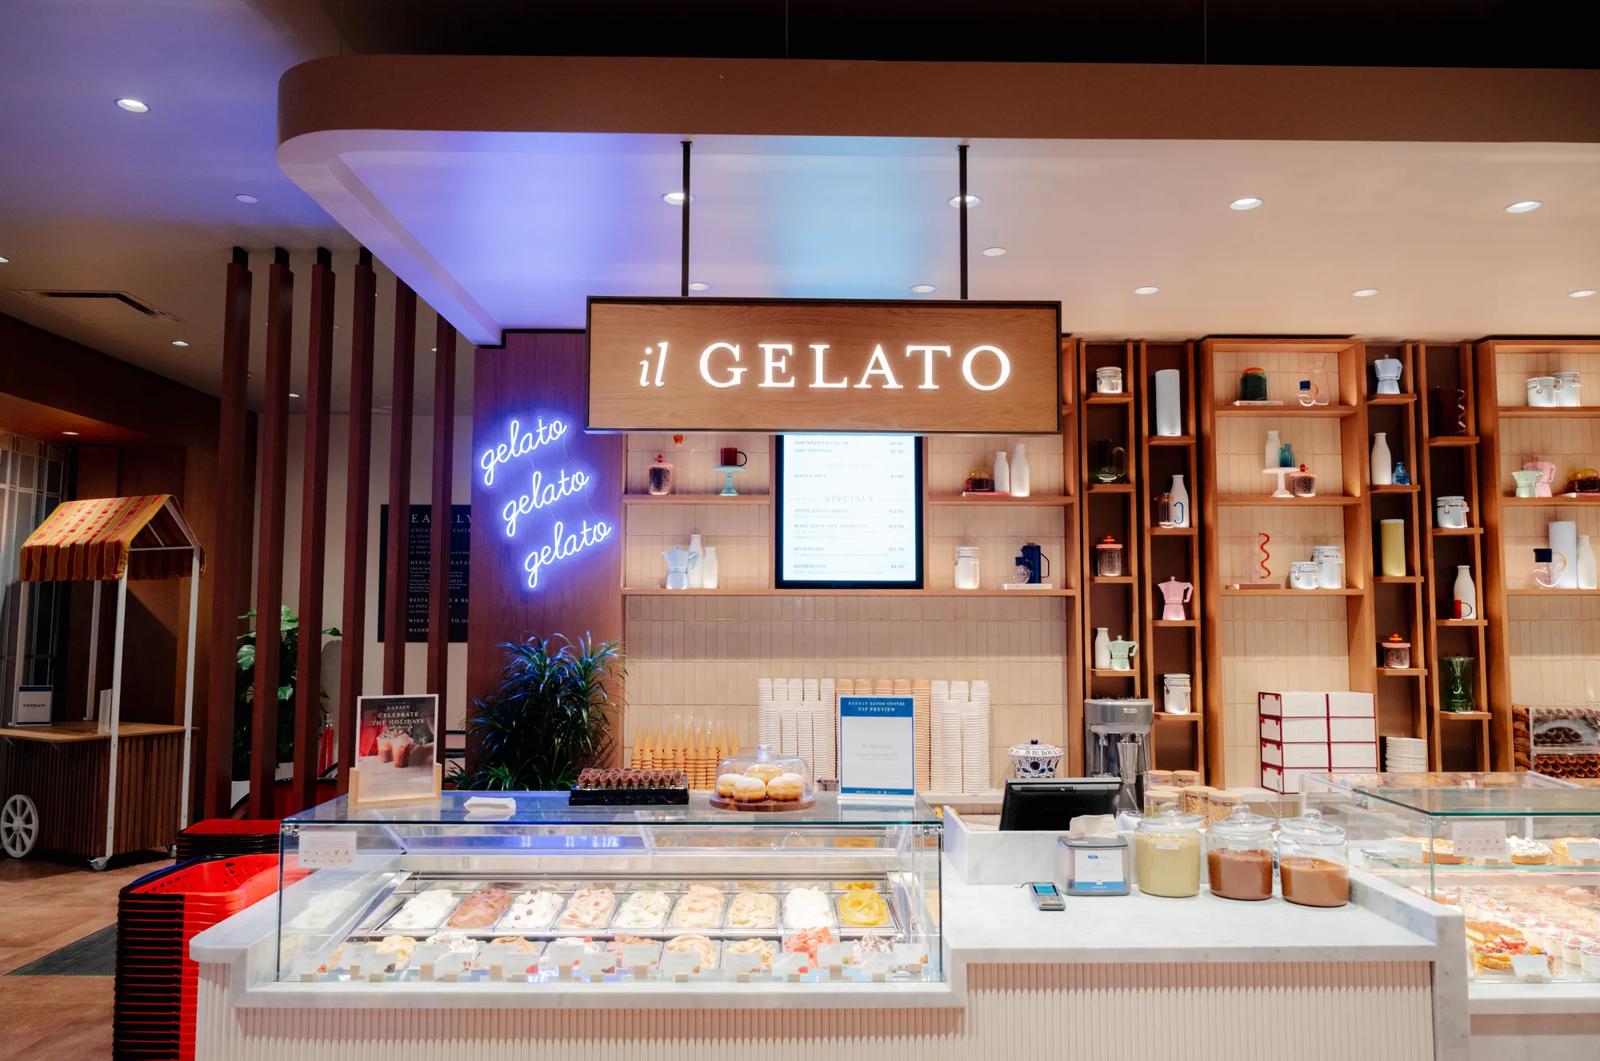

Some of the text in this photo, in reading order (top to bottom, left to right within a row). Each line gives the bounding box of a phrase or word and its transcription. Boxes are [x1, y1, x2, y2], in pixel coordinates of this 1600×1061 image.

[639, 341, 1011, 391] il GELATO
[481, 419, 567, 486] gelato
[411, 513, 472, 524] EALY
[503, 470, 589, 537] gelato
[525, 521, 611, 588] gelato
[377, 711, 419, 719] CELEBRATE
[388, 718, 425, 726] HOLIDAYS
